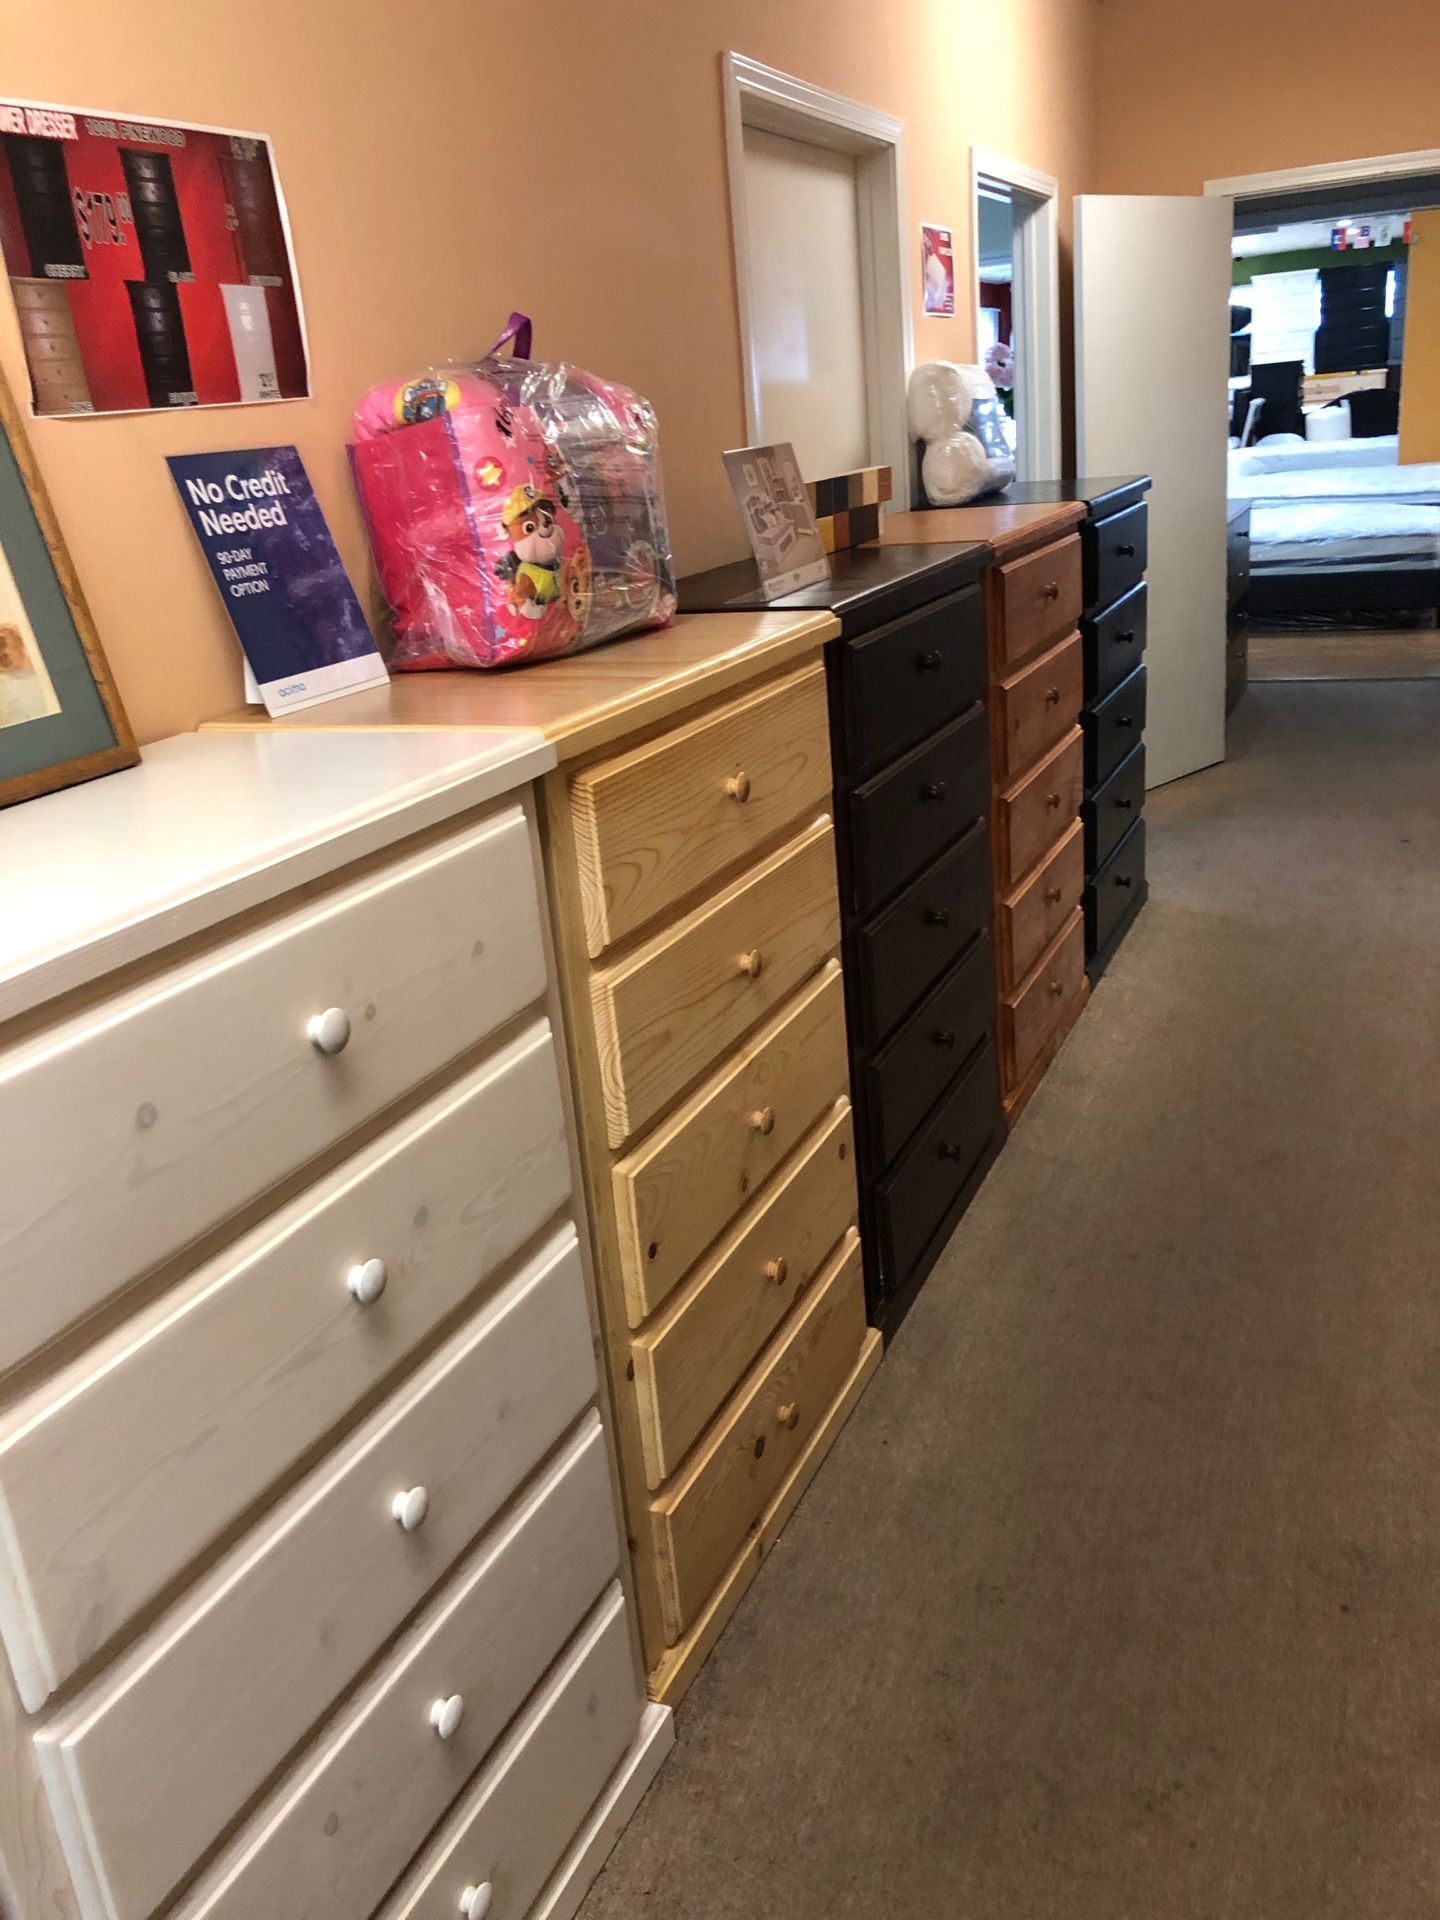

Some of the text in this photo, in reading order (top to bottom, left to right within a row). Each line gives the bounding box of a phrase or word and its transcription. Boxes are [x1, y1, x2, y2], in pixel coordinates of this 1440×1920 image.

[185, 469, 291, 506] No Credit
[197, 499, 288, 537] Needed
[216, 547, 253, 565] 90-DAY
[222, 562, 269, 581] PAYMENT
[229, 579, 271, 598] OPTION
